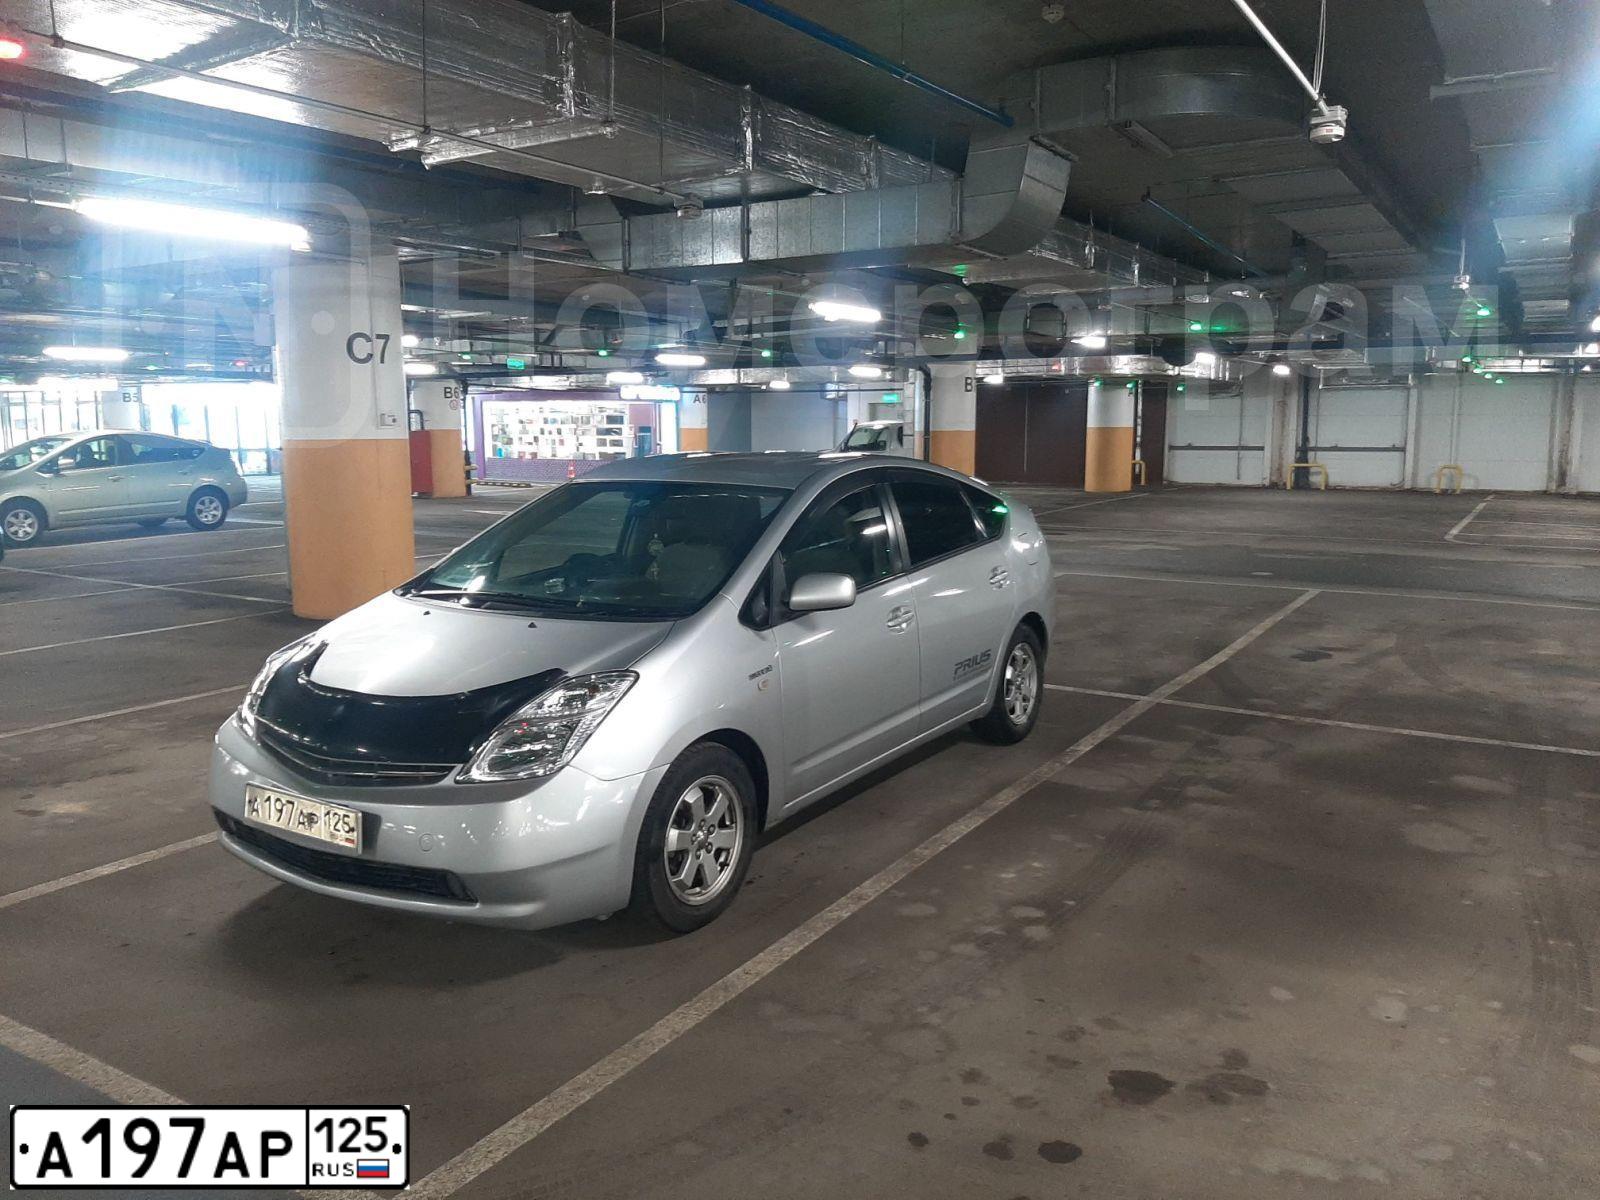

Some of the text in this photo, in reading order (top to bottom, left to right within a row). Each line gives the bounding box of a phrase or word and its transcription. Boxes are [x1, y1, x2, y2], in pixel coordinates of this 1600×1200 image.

[345, 332, 391, 365] C7
[443, 386, 460, 399] B6
[954, 649, 992, 675] PRIUS
